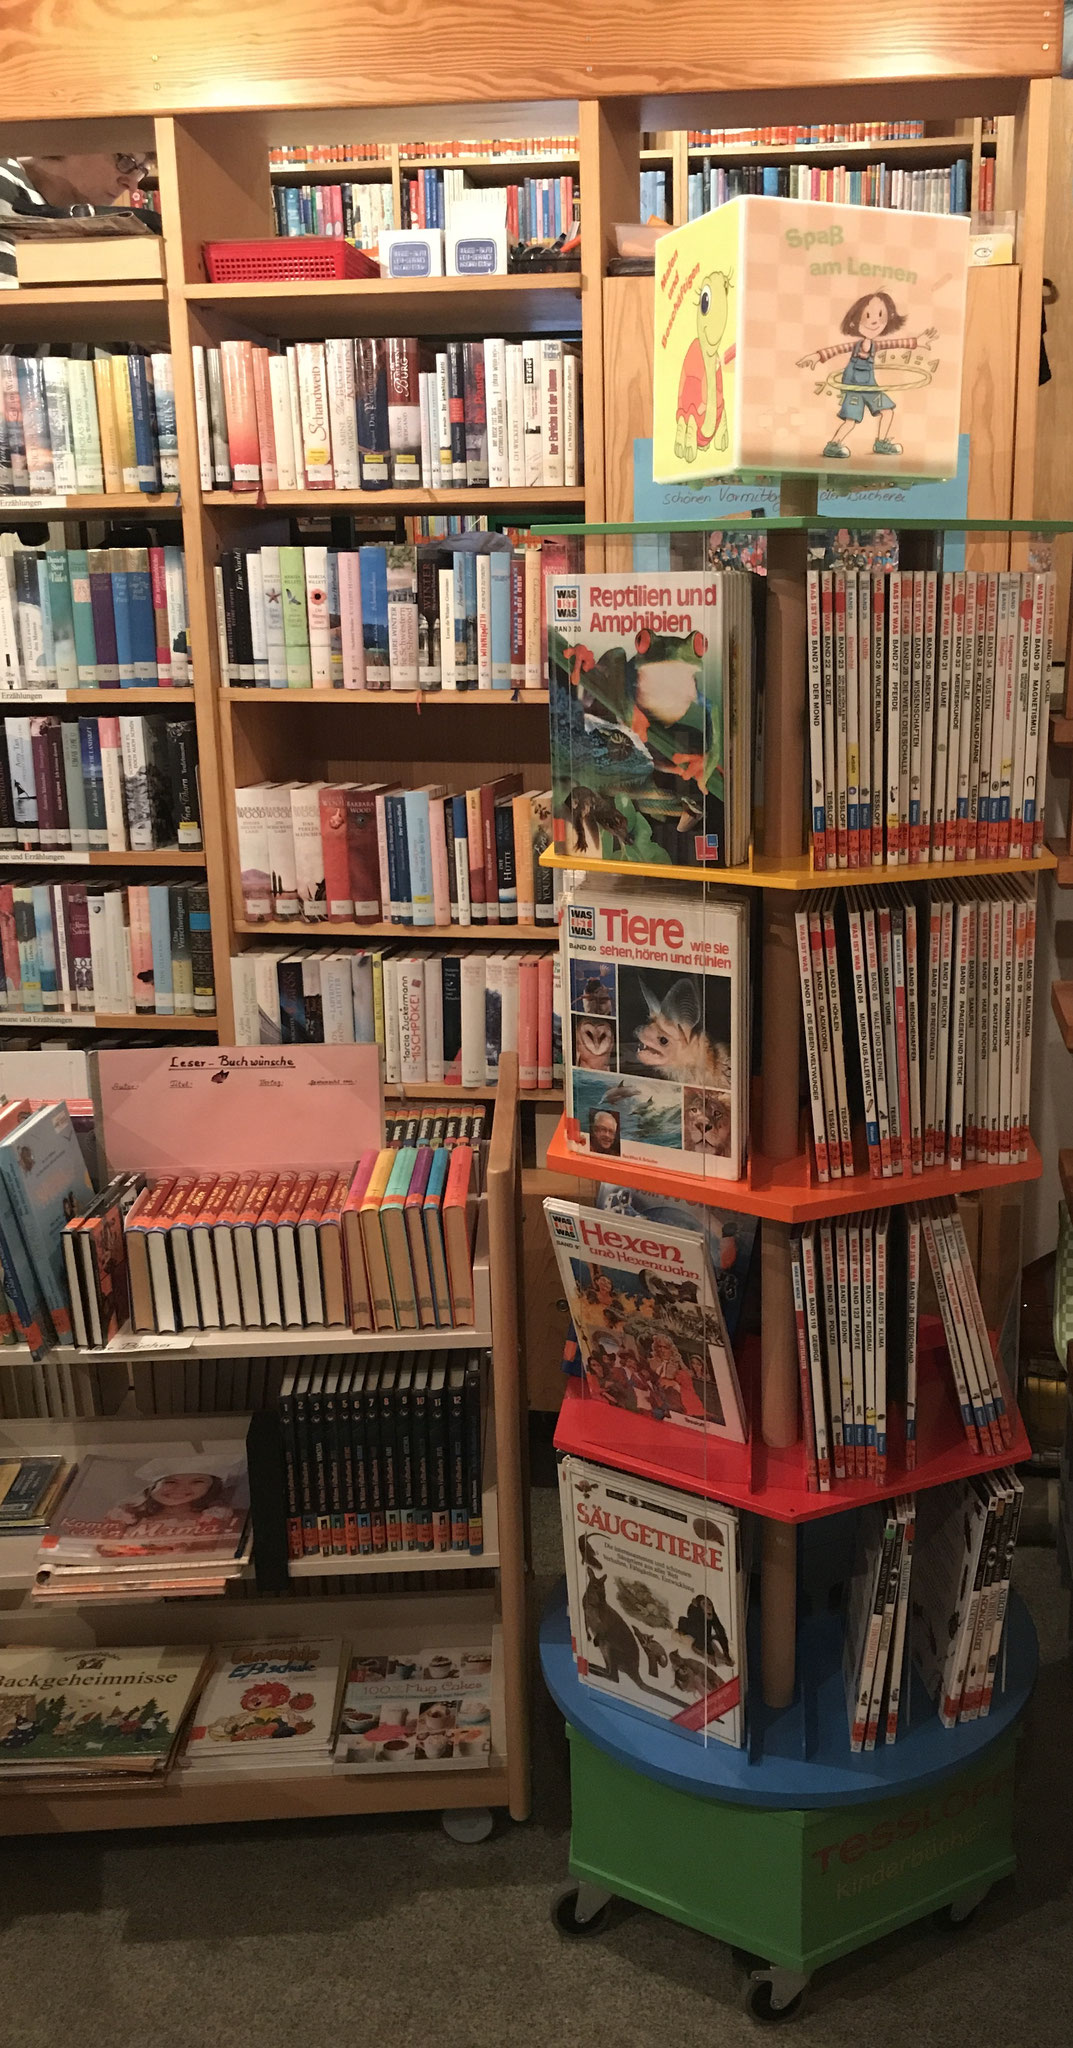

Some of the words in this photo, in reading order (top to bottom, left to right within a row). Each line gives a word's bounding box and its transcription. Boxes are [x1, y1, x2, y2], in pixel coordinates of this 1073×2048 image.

[785, 225, 844, 250] Spaß
[810, 261, 842, 276] am
[847, 257, 918, 285] Lernen
[668, 270, 679, 300] und
[395, 358, 409, 397] BURG
[309, 366, 327, 441] Schandweib
[164, 399, 175, 445] SPARKS
[233, 551, 243, 572] Nacht
[423, 563, 432, 609] WINTER
[557, 589, 577, 599] WAS
[590, 585, 671, 610] Reptilien
[677, 584, 717, 607] und
[557, 599, 577, 609] IST
[557, 608, 577, 618] WAS
[574, 625, 582, 633] 20
[590, 611, 692, 636] Amphibien
[1, 692, 43, 701] Erzählungen
[237, 810, 265, 818] WOOD
[24, 852, 66, 862] Erzählungen
[571, 908, 593, 920] WAS
[177, 896, 185, 949] Verschwiegene
[599, 908, 684, 949] Tiere
[571, 926, 593, 937] WAS
[569, 942, 587, 951] BAND
[690, 942, 712, 953] wie
[714, 942, 730, 955] sie
[599, 945, 634, 960] sehen,
[635, 948, 668, 962] hören
[670, 953, 692, 965] und
[694, 953, 732, 969] fühlen
[855, 974, 863, 994] BAND
[401, 976, 410, 1032] Zuckermann
[33, 1015, 72, 1024] Erzählungen
[402, 1033, 410, 1063] Marcia
[170, 1056, 207, 1067] Leser
[876, 1050, 884, 1082] DELPHINE
[809, 1052, 819, 1100] WELTWUNDER
[552, 1215, 572, 1226] WAS
[555, 1228, 576, 1239] WAS
[579, 1219, 685, 1264] Hexen
[588, 1246, 615, 1260] und
[617, 1250, 701, 1281] Hexenwahn
[811, 1335, 819, 1363] GEBIRGE
[327, 1401, 333, 1409] 4
[342, 1400, 348, 1408] 5
[369, 1399, 375, 1407] 7
[384, 1397, 389, 1406] 8
[402, 1396, 408, 1405] 9
[416, 1396, 425, 1405] 10
[434, 1398, 442, 1407] 11
[453, 1396, 462, 1404] 12
[313, 1403, 320, 1411] 3
[577, 1502, 724, 1572] SÄUGETIERE
[974, 1595, 989, 1651] ERFINDUNGEN
[405, 1683, 438, 1694] Mug
[441, 1680, 482, 1692] Cakes
